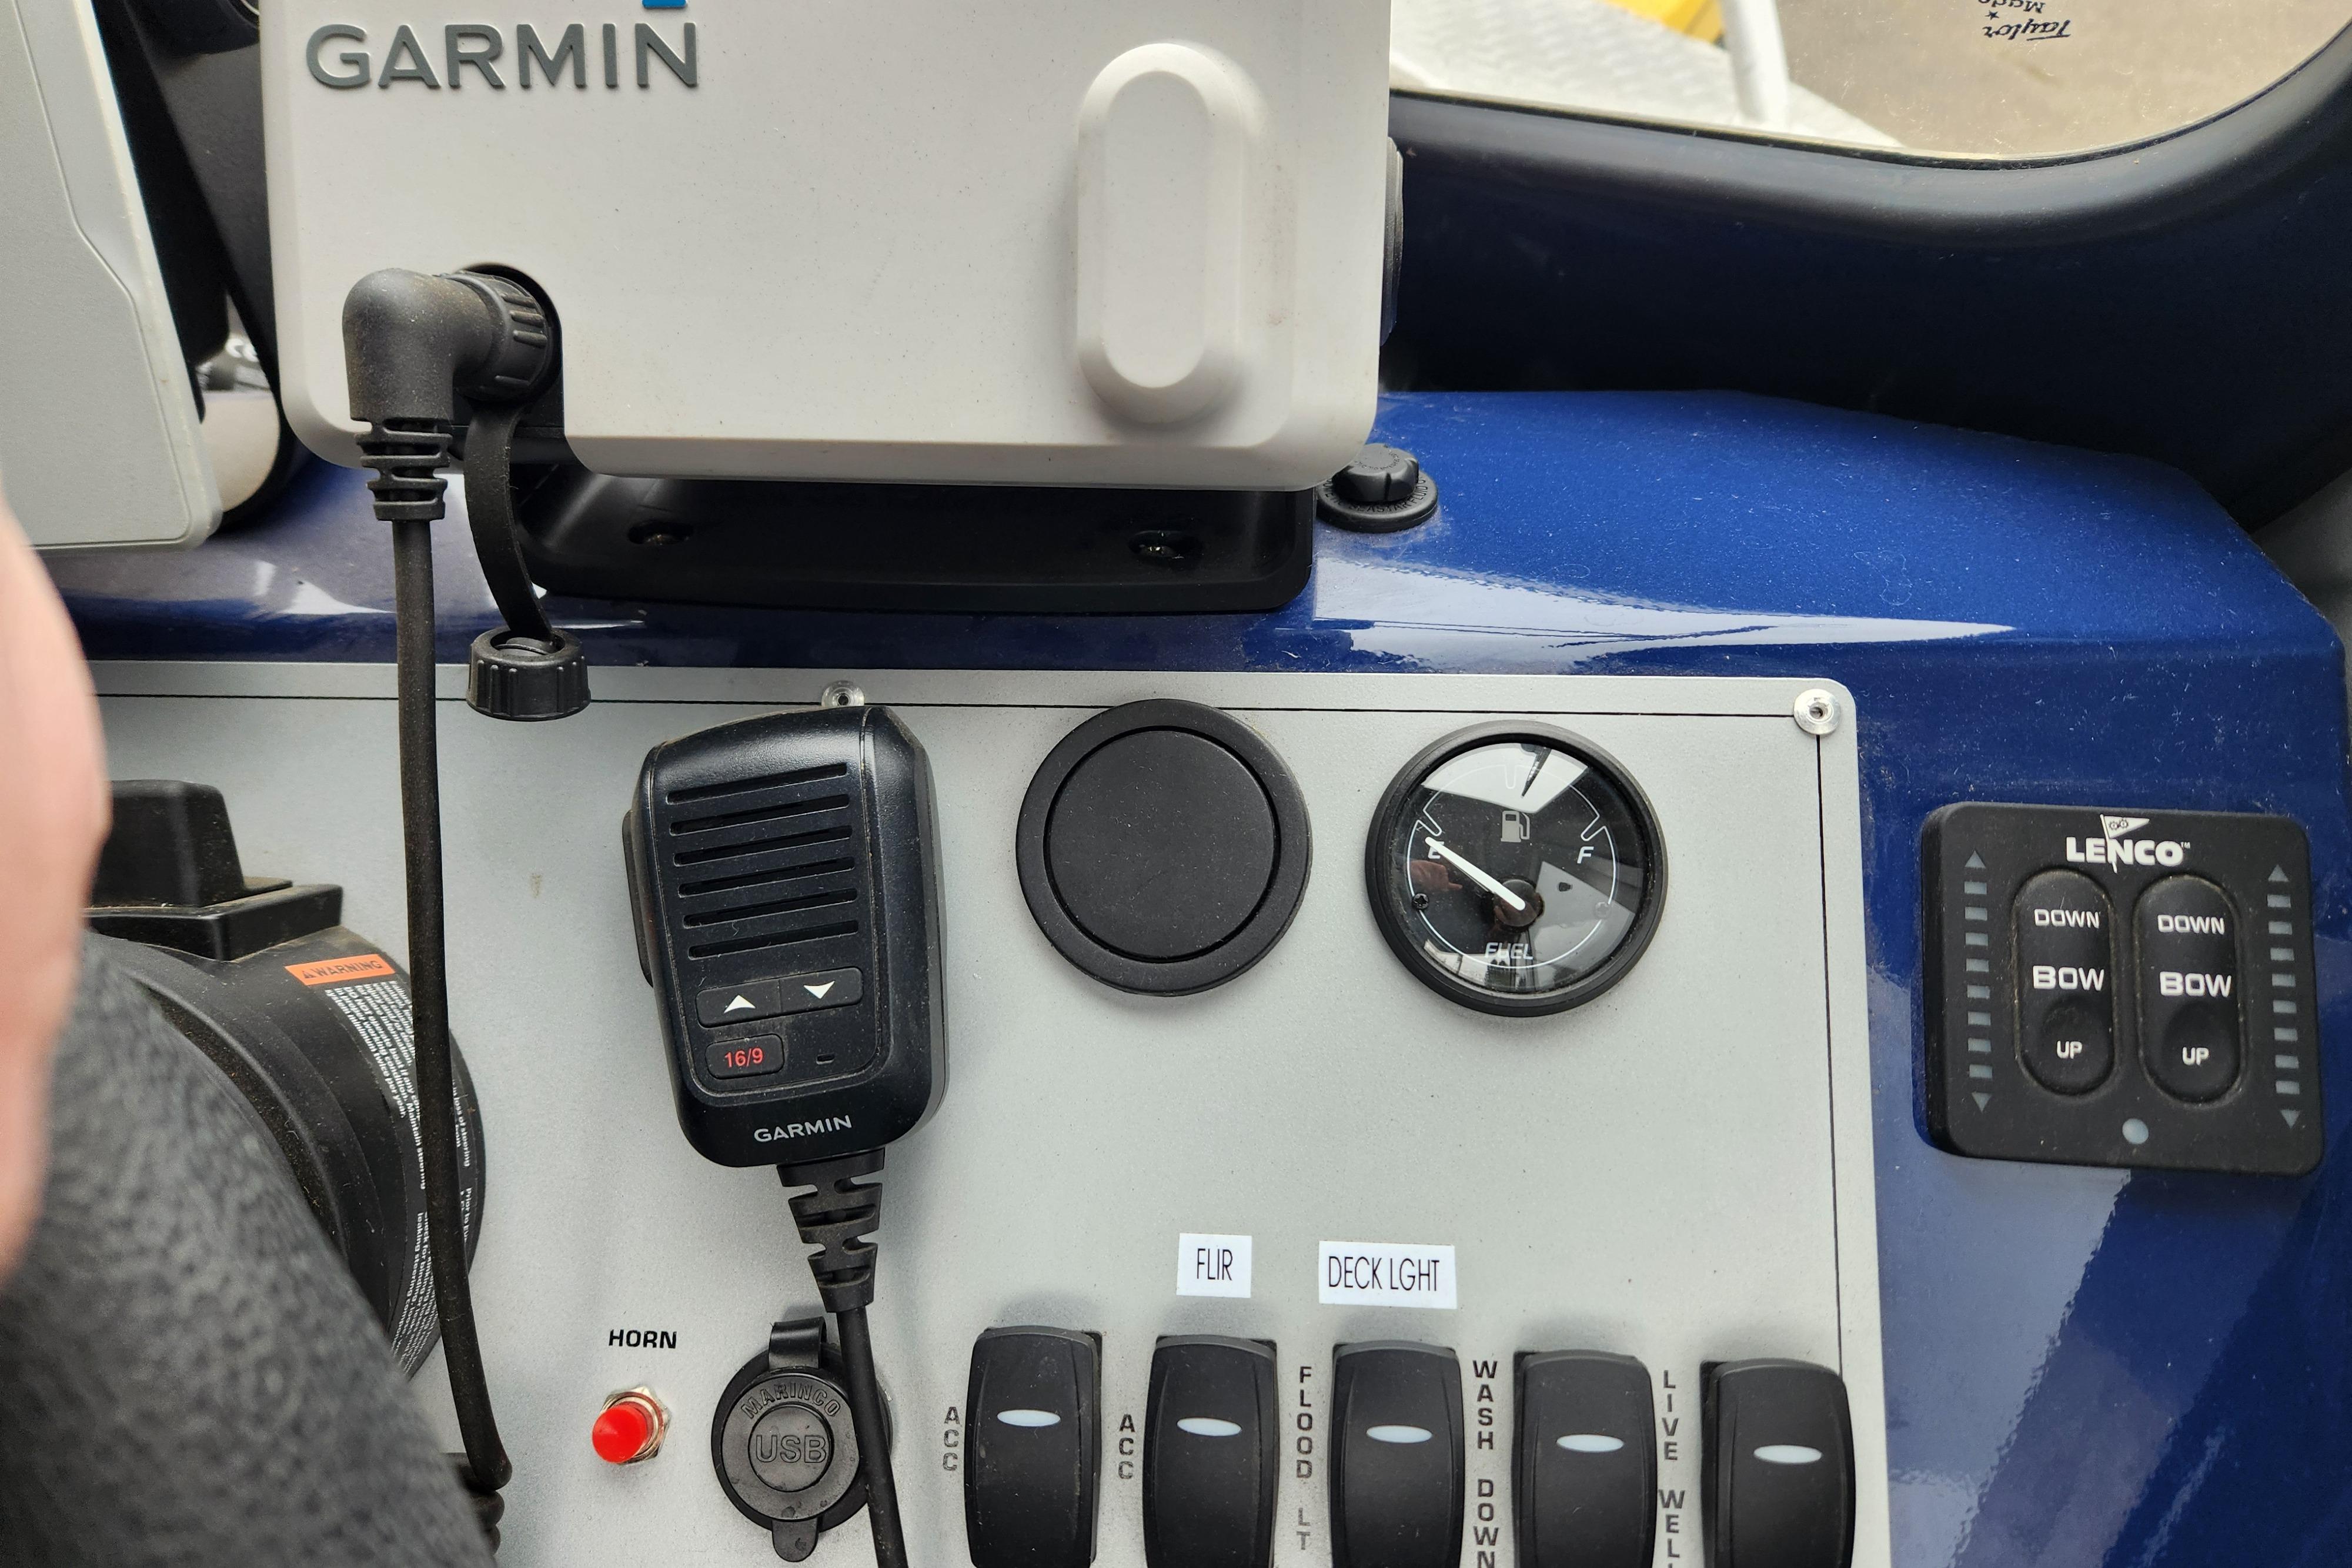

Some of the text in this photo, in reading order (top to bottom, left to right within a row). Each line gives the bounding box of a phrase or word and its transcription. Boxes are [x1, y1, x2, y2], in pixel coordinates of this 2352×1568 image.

[1982, 18, 2071, 41] Taylor
[306, 23, 698, 89] GARMIN
[1577, 846, 1594, 864] F
[2066, 836, 2184, 868] LENCO
[2034, 908, 2100, 929] DOWN
[2157, 914, 2225, 935] DOWN
[1484, 942, 1534, 959] FUEL
[311, 960, 382, 977] WARNING
[2032, 965, 2105, 992] BOW
[2159, 971, 2232, 998] BOW
[364, 996, 385, 1015] more
[325, 989, 352, 1015] system
[347, 1014, 377, 1052] minimum
[373, 1053, 390, 1076] twice
[385, 1078, 397, 1094] per
[343, 987, 359, 998] DO
[354, 999, 373, 1015] NOT
[368, 1016, 392, 1047] operate
[389, 1048, 405, 1069] boat
[403, 1077, 415, 1094] any
[2056, 1041, 2083, 1059] UP
[2181, 1047, 2210, 1065] UP
[340, 996, 367, 1021] proper
[363, 1021, 389, 1055] working
[385, 1057, 409, 1101] condition.
[406, 1102, 422, 1146] Maintain
[724, 1048, 764, 1068] 16/9
[754, 1115, 852, 1142] GARMIN
[461, 1127, 470, 1166] steering
[415, 1212, 424, 1252] leaking
[407, 1254, 419, 1297] steering
[1196, 1248, 1233, 1281] FLIR
[1328, 1256, 1440, 1292] DECK LGHT
[608, 1329, 677, 1349] HORN
[740, 1382, 841, 1419] MARINCO
[756, 1435, 828, 1463] USB
[943, 1406, 960, 1472] ACC
[1118, 1414, 1135, 1480] ACC
[1297, 1366, 1314, 1550] FLOOD LT
[1473, 1360, 1499, 1568] WASH DOWN
[1658, 1369, 1685, 1568] LIVE WEL
